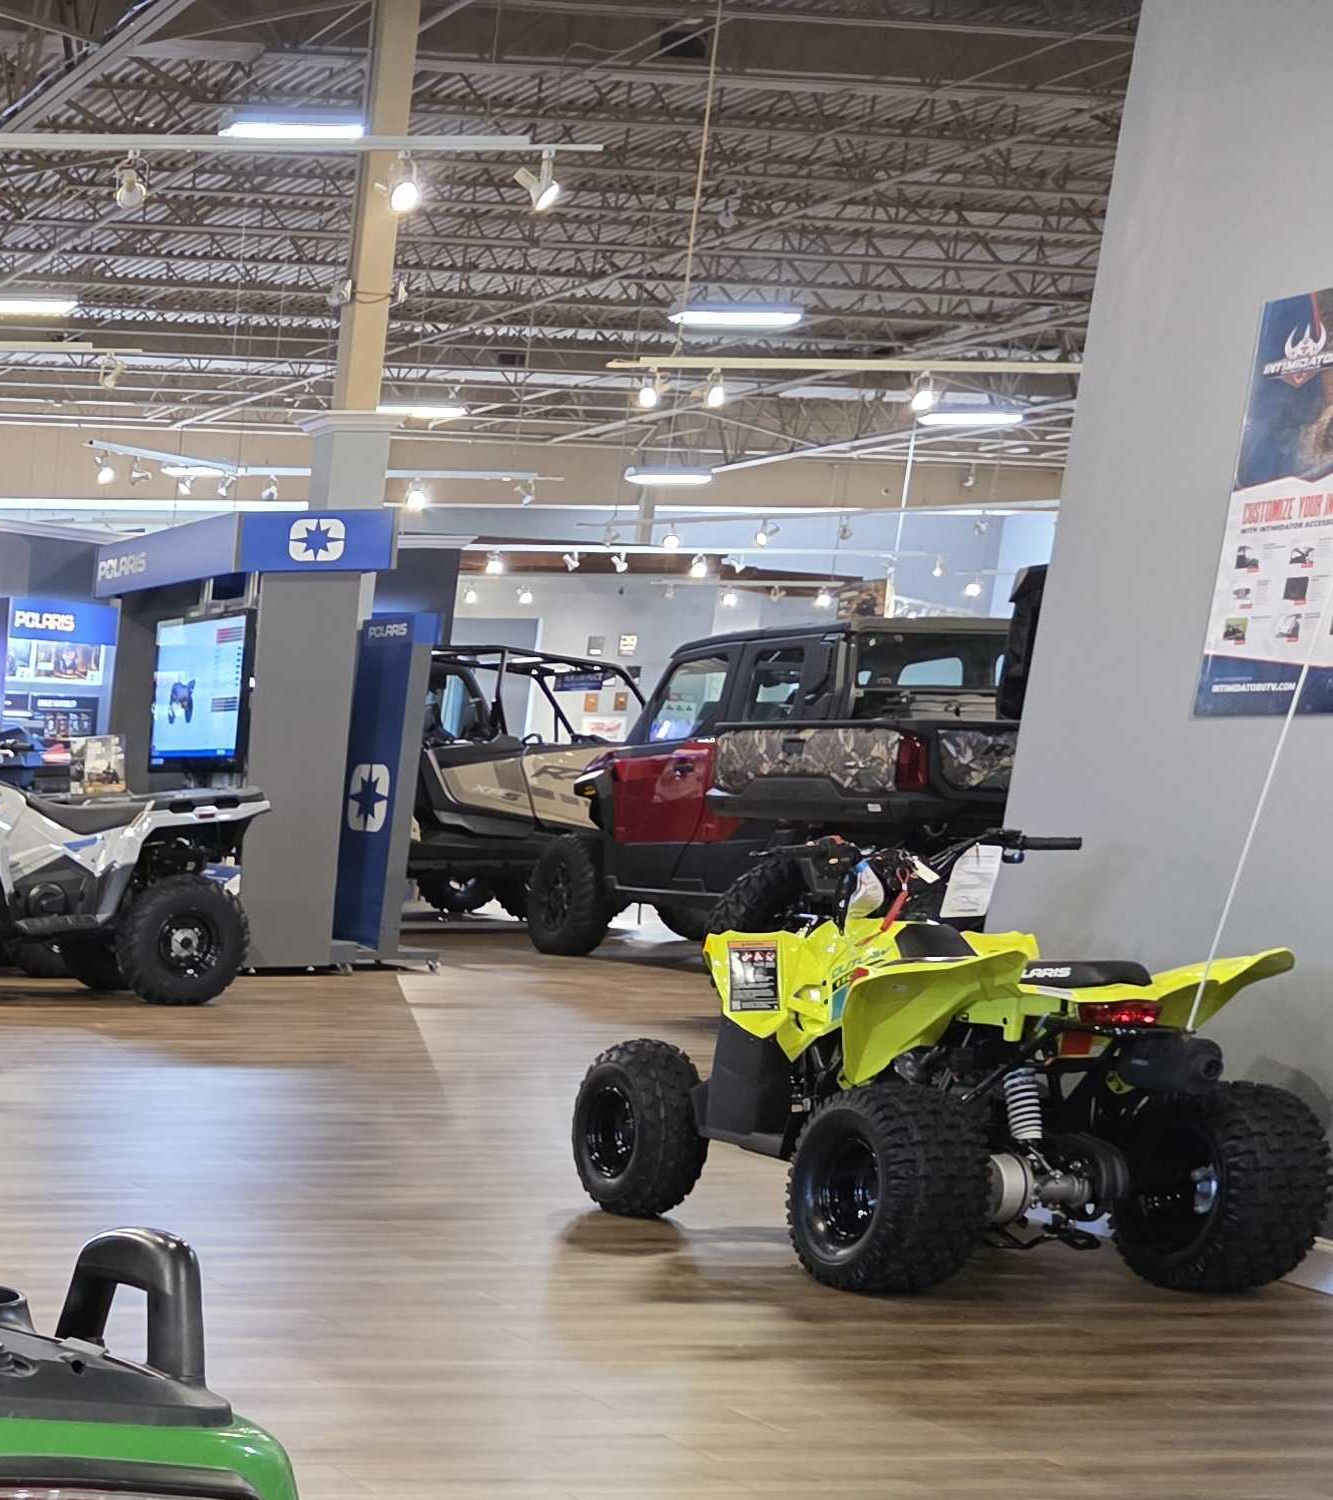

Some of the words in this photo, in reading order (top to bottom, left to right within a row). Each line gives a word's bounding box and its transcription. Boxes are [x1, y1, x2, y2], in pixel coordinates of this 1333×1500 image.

[1263, 353, 1333, 375] INTIMIDATO
[98, 552, 147, 579] POLARIS
[14, 610, 75, 632] POLARIS
[368, 623, 407, 639] POLARIS
[1020, 967, 1071, 978] LARIS
